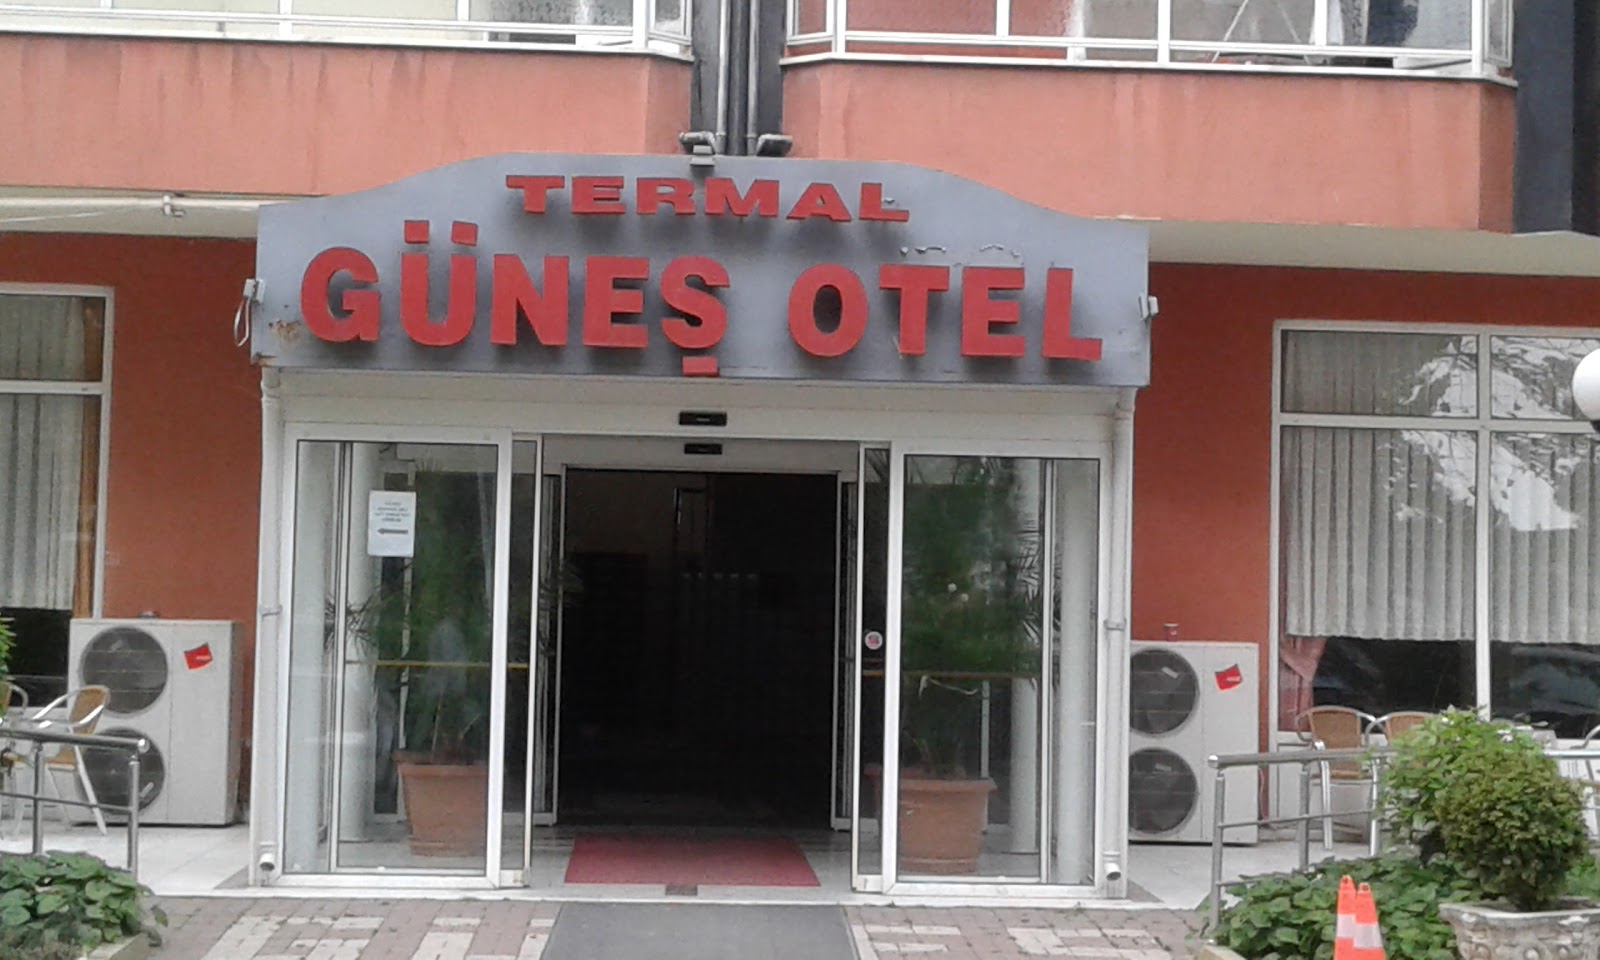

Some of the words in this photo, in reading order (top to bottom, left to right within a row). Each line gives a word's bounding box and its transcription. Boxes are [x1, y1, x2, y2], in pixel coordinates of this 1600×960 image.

[506, 175, 909, 221] TERMAL
[301, 220, 730, 377] GÜNEŞ
[788, 263, 1102, 361] OTEL
